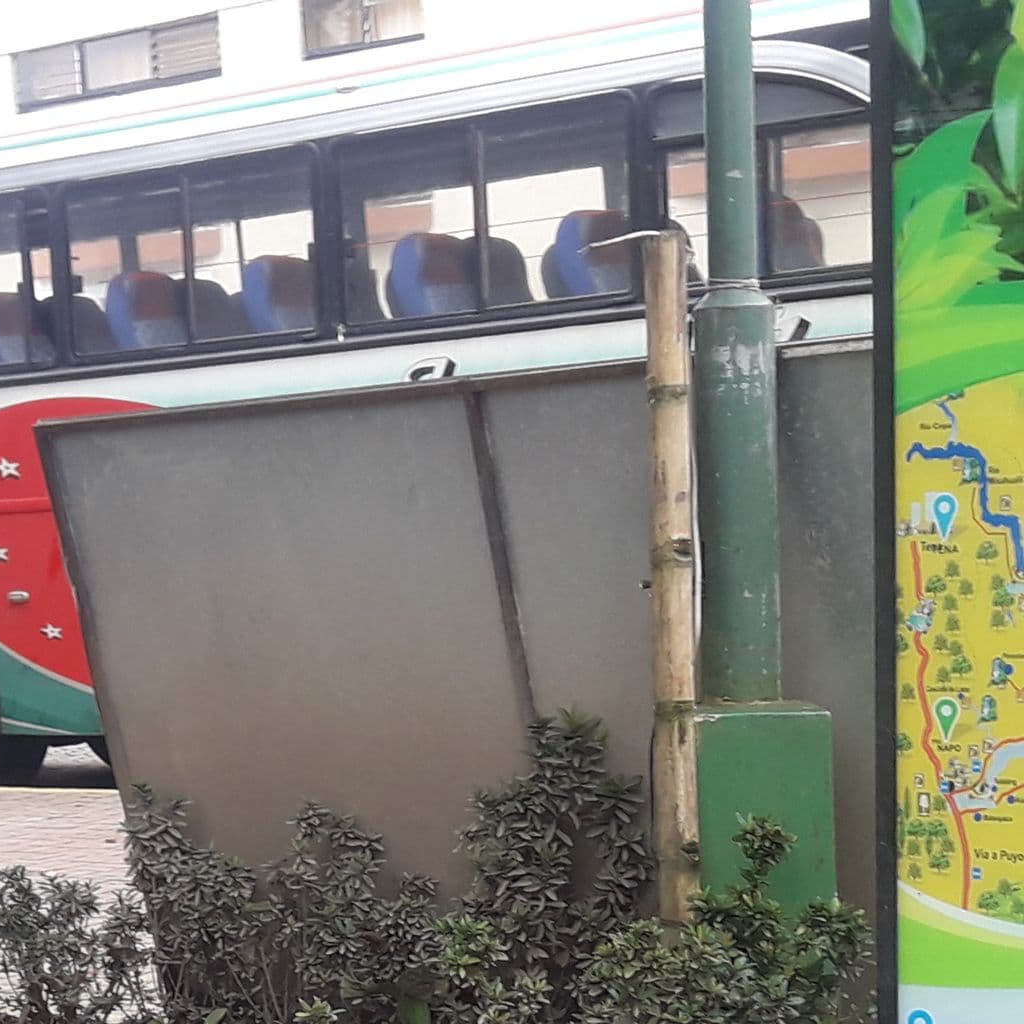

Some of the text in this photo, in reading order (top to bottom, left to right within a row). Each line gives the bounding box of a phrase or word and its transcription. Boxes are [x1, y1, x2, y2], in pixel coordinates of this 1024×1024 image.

[937, 744, 962, 752] NAPO
[991, 852, 998, 860] a
[999, 850, 1024, 864] Puyo
